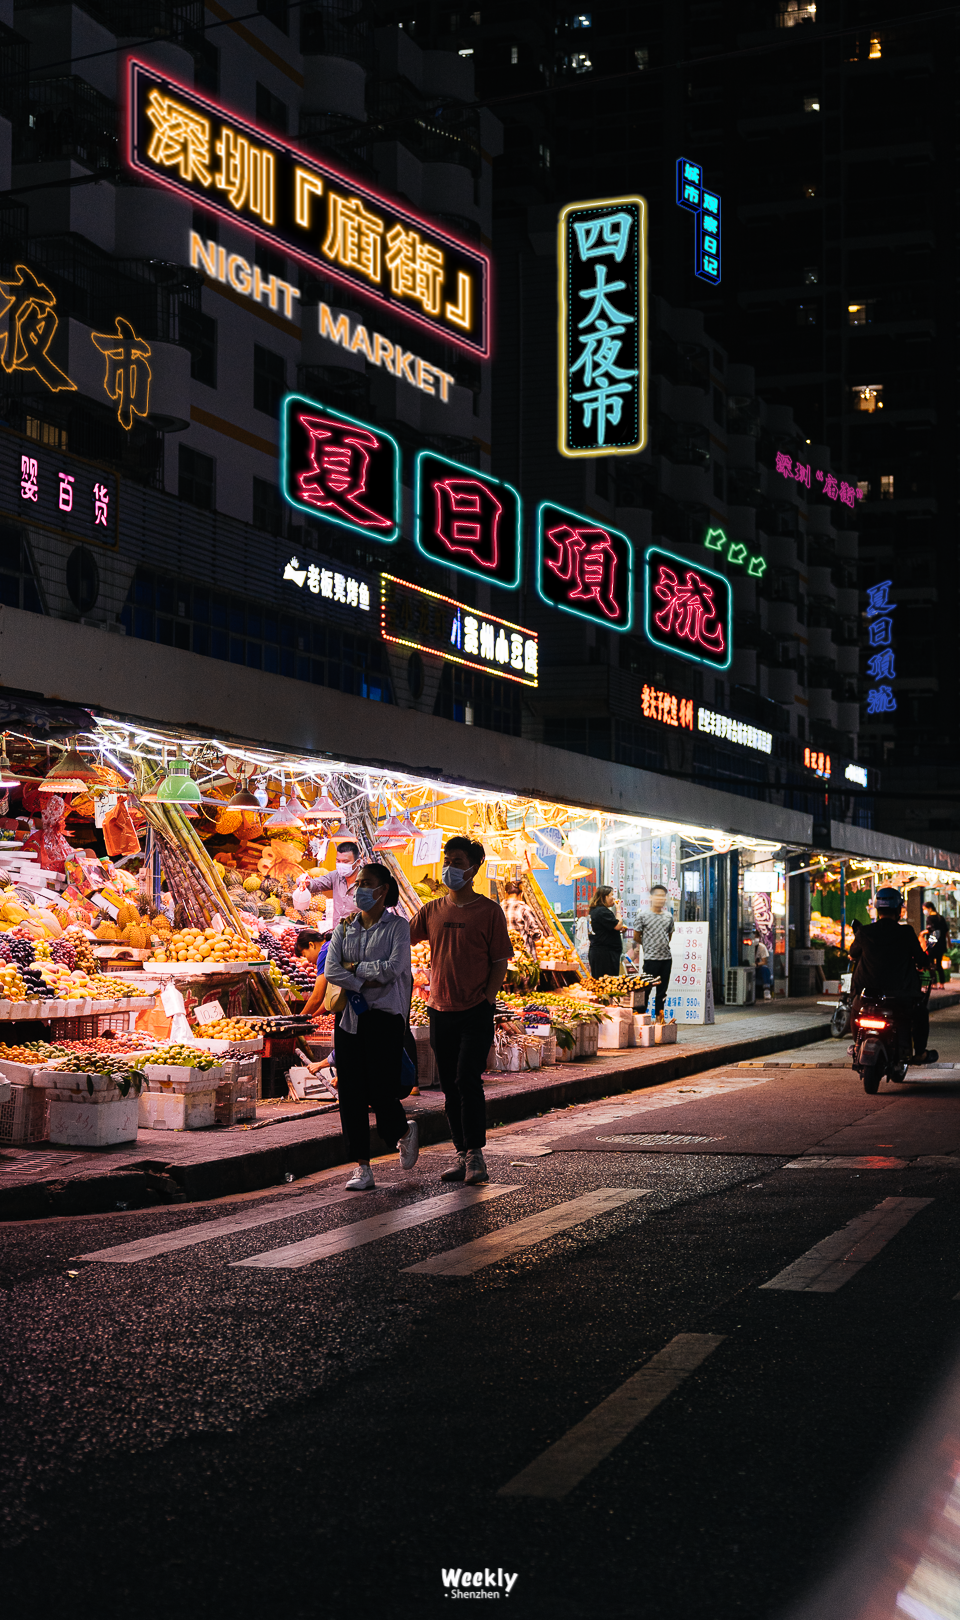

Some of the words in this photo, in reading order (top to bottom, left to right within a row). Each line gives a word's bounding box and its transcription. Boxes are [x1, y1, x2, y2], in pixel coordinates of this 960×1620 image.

[683, 164, 700, 204] 城市
[702, 192, 719, 276] 观察日记
[0, 264, 153, 430] 夜市
[187, 228, 302, 320] NIGHT
[317, 301, 455, 404] MARKET
[570, 211, 639, 446] 四大夜市
[20, 455, 109, 526] 婴百货
[306, 563, 370, 611] 老板凳烤鱼
